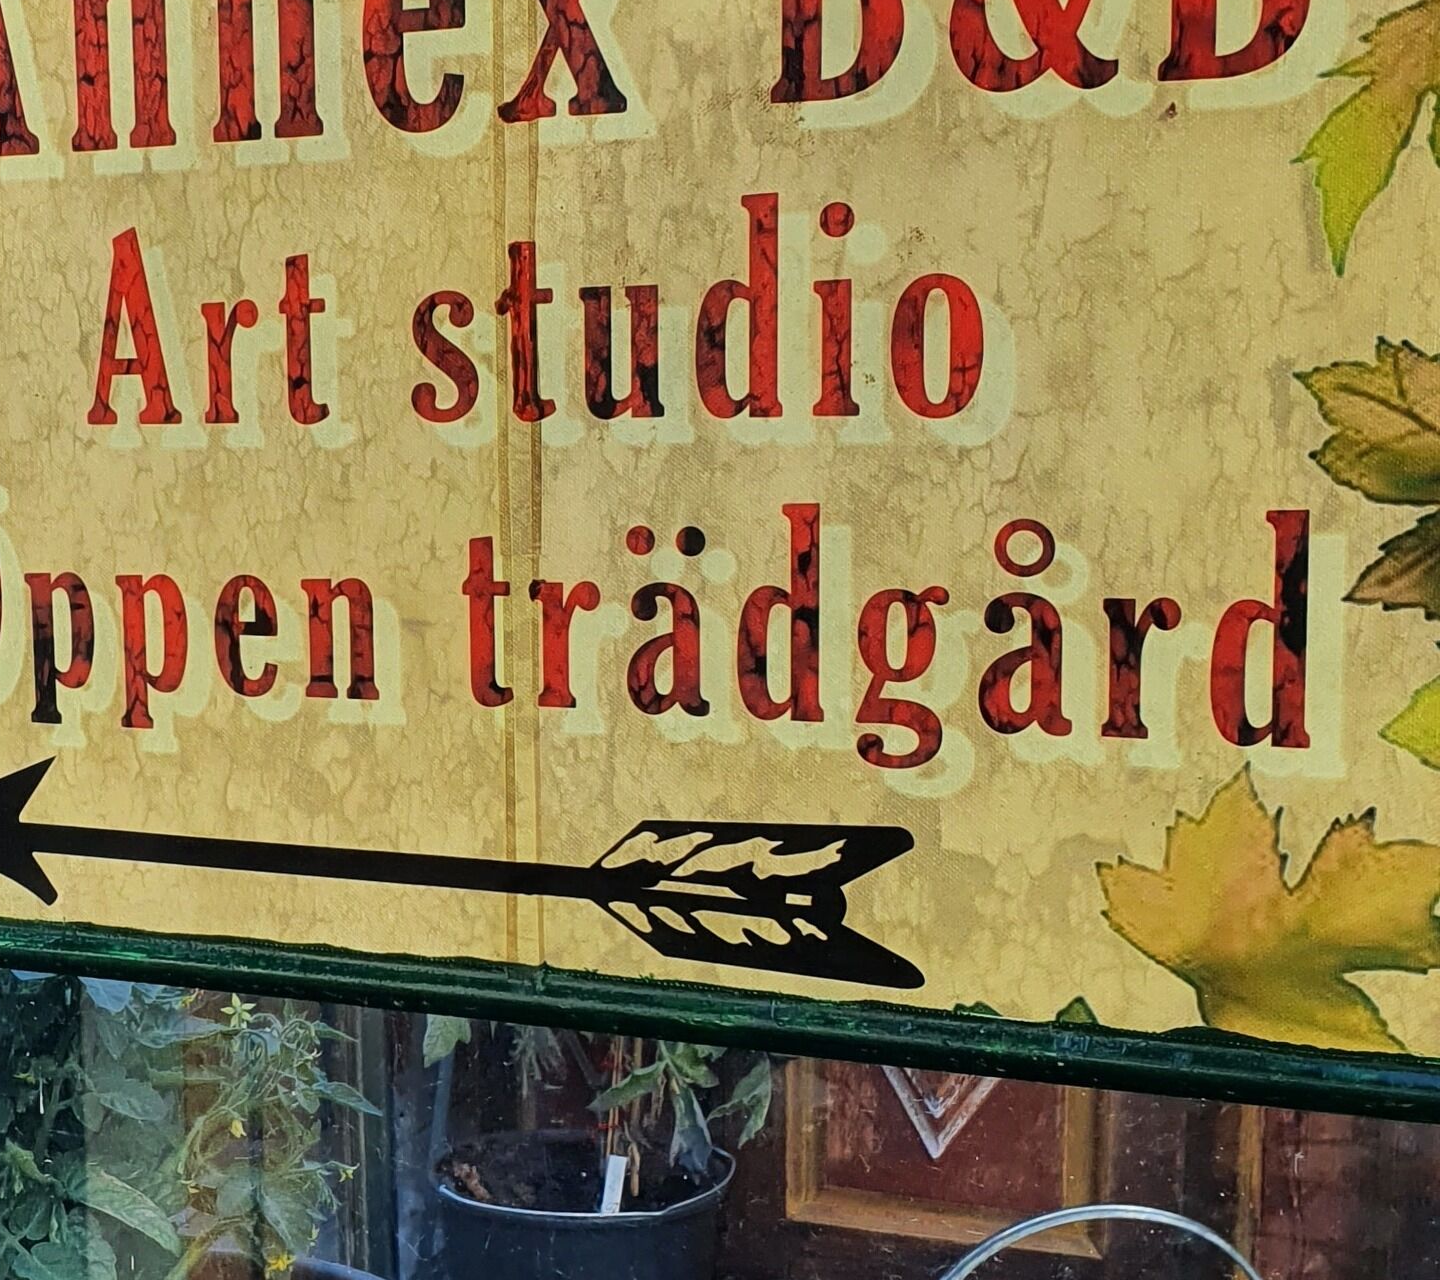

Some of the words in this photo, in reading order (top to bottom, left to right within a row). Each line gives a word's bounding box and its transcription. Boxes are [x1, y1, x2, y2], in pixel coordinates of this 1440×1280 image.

[87, 228, 330, 427] Art
[411, 193, 985, 424] studio
[464, 502, 1313, 769] trädgård
